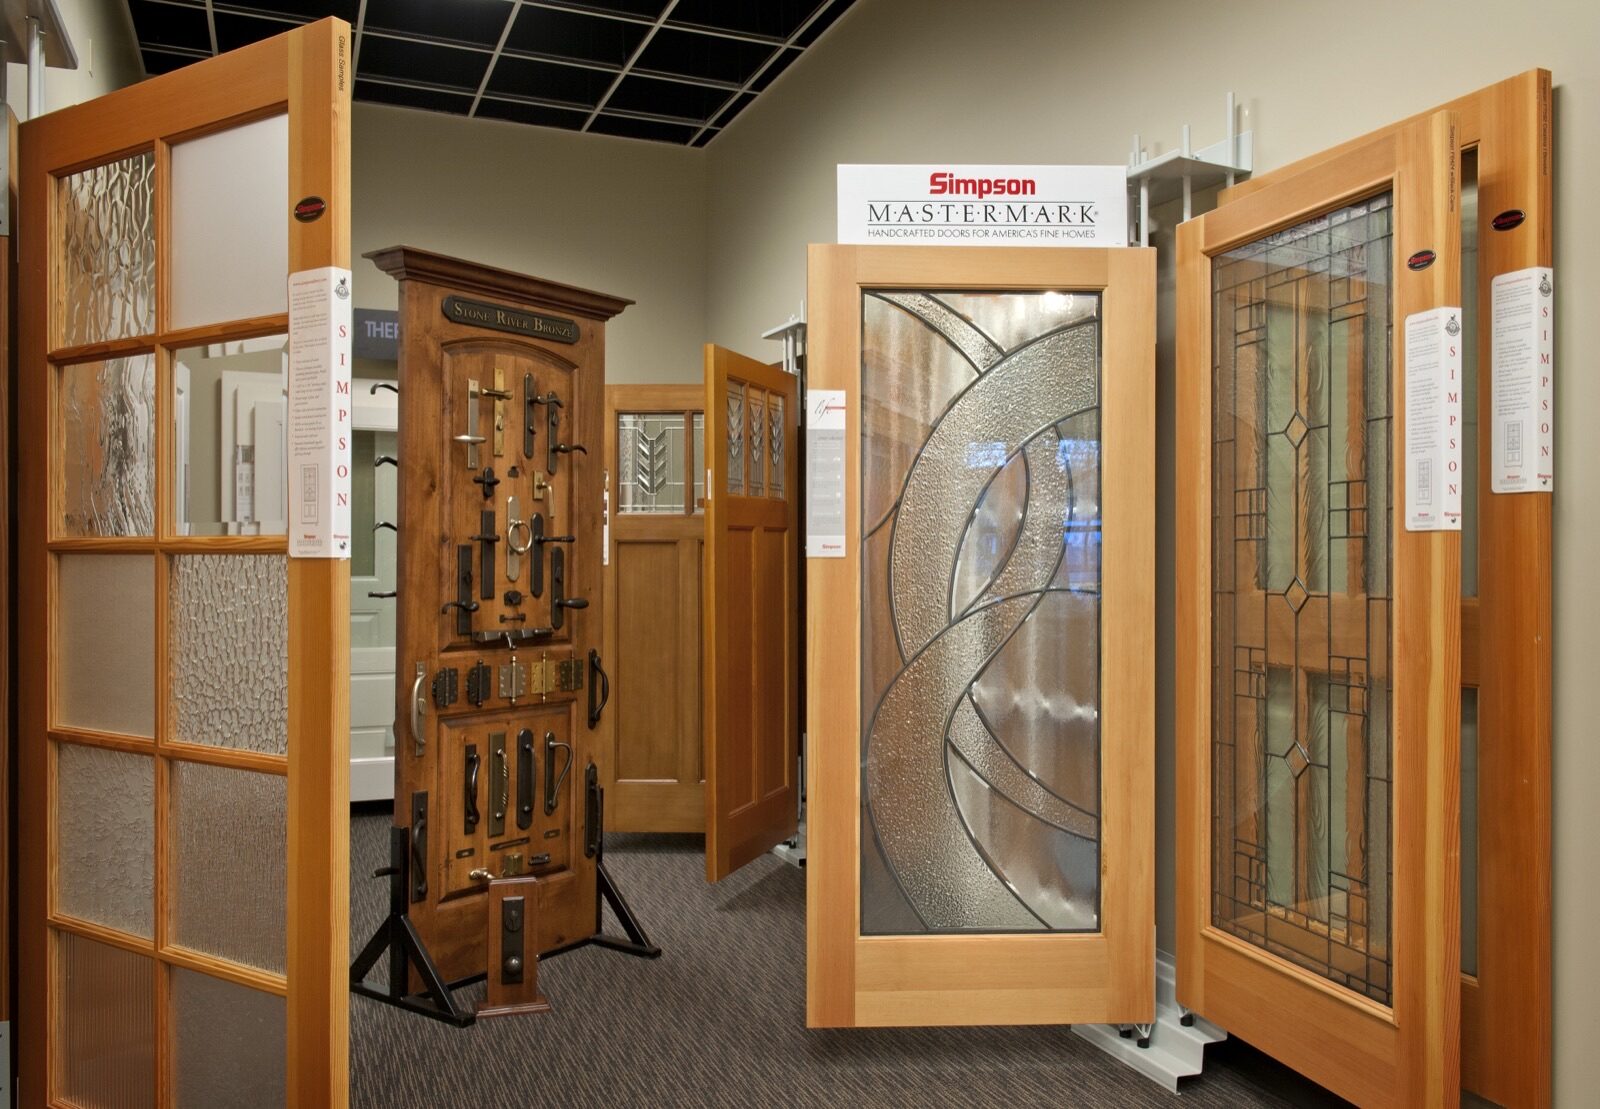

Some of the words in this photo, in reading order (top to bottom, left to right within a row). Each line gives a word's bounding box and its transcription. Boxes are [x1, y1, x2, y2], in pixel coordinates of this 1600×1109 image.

[338, 35, 346, 58] Glass
[338, 59, 346, 92] Samples
[929, 172, 1036, 200] Simpson
[867, 228, 936, 238] HANDCRAFTED
[937, 229, 971, 239] DOORS
[972, 229, 990, 239] FOR
[991, 229, 1039, 239] AMERICA'S
[1040, 229, 1060, 239] FINE
[1062, 229, 1096, 239] HOMES
[1541, 306, 1550, 457] SIMPSON
[336, 325, 349, 507] SIMPSON
[1447, 346, 1458, 495] SIMPSON
